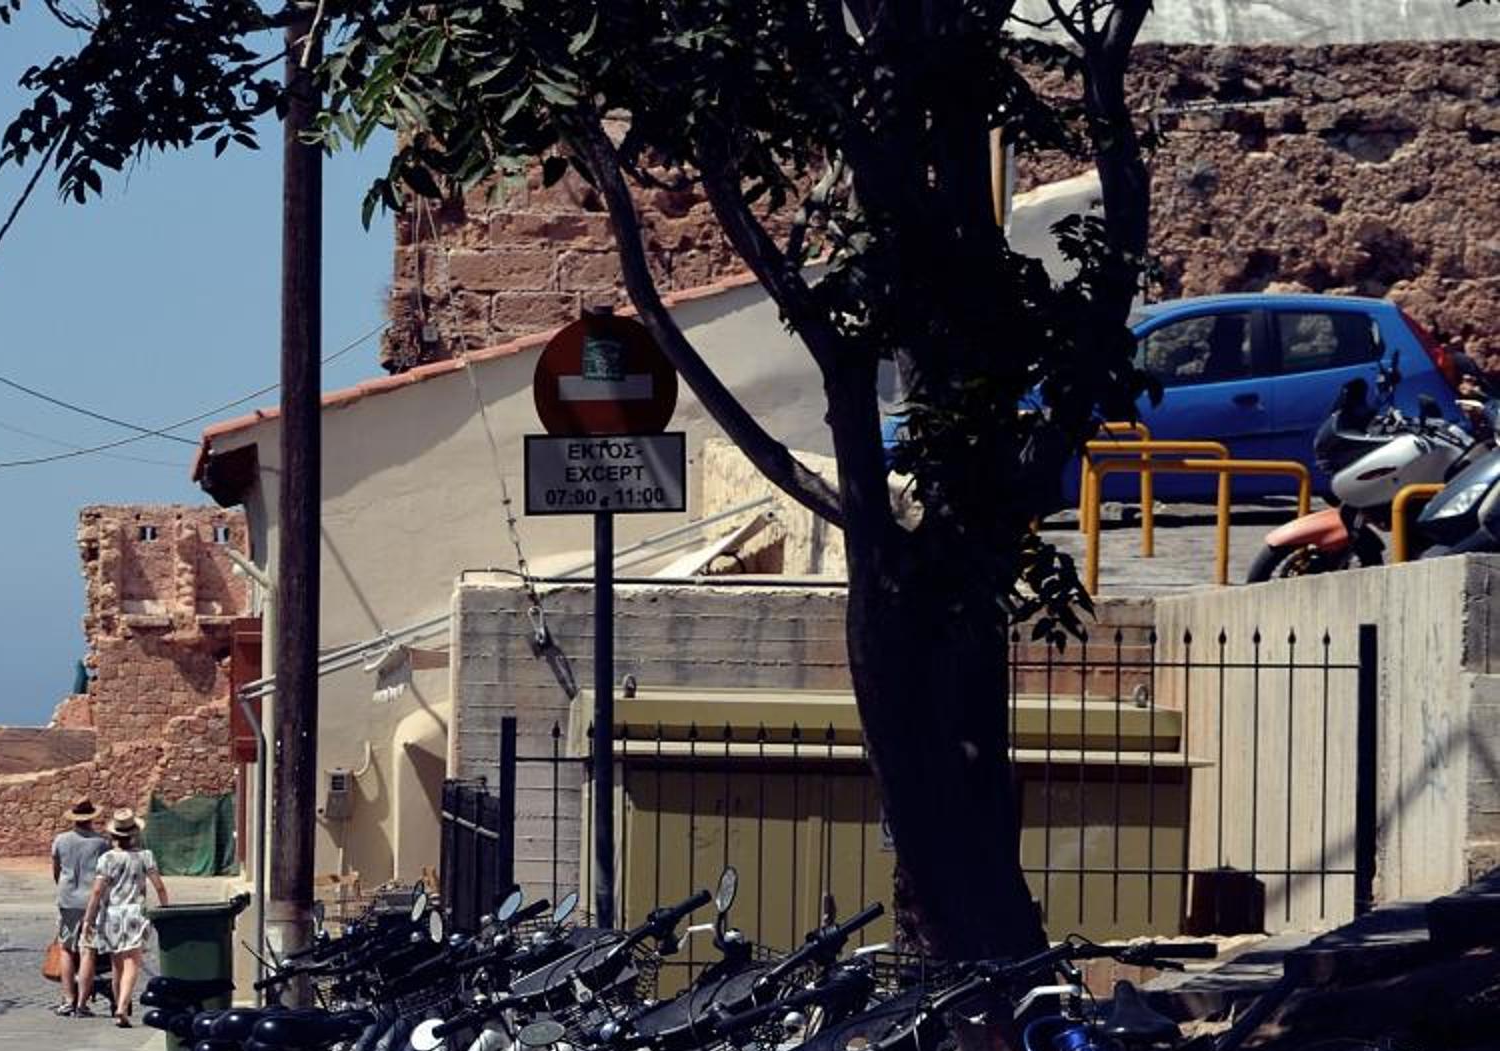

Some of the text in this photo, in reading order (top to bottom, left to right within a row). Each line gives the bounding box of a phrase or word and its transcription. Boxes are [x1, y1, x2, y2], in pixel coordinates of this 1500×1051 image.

[565, 465, 645, 483] EXCEPT
[545, 489, 598, 506] 07:00
[614, 487, 665, 504] 11:00
